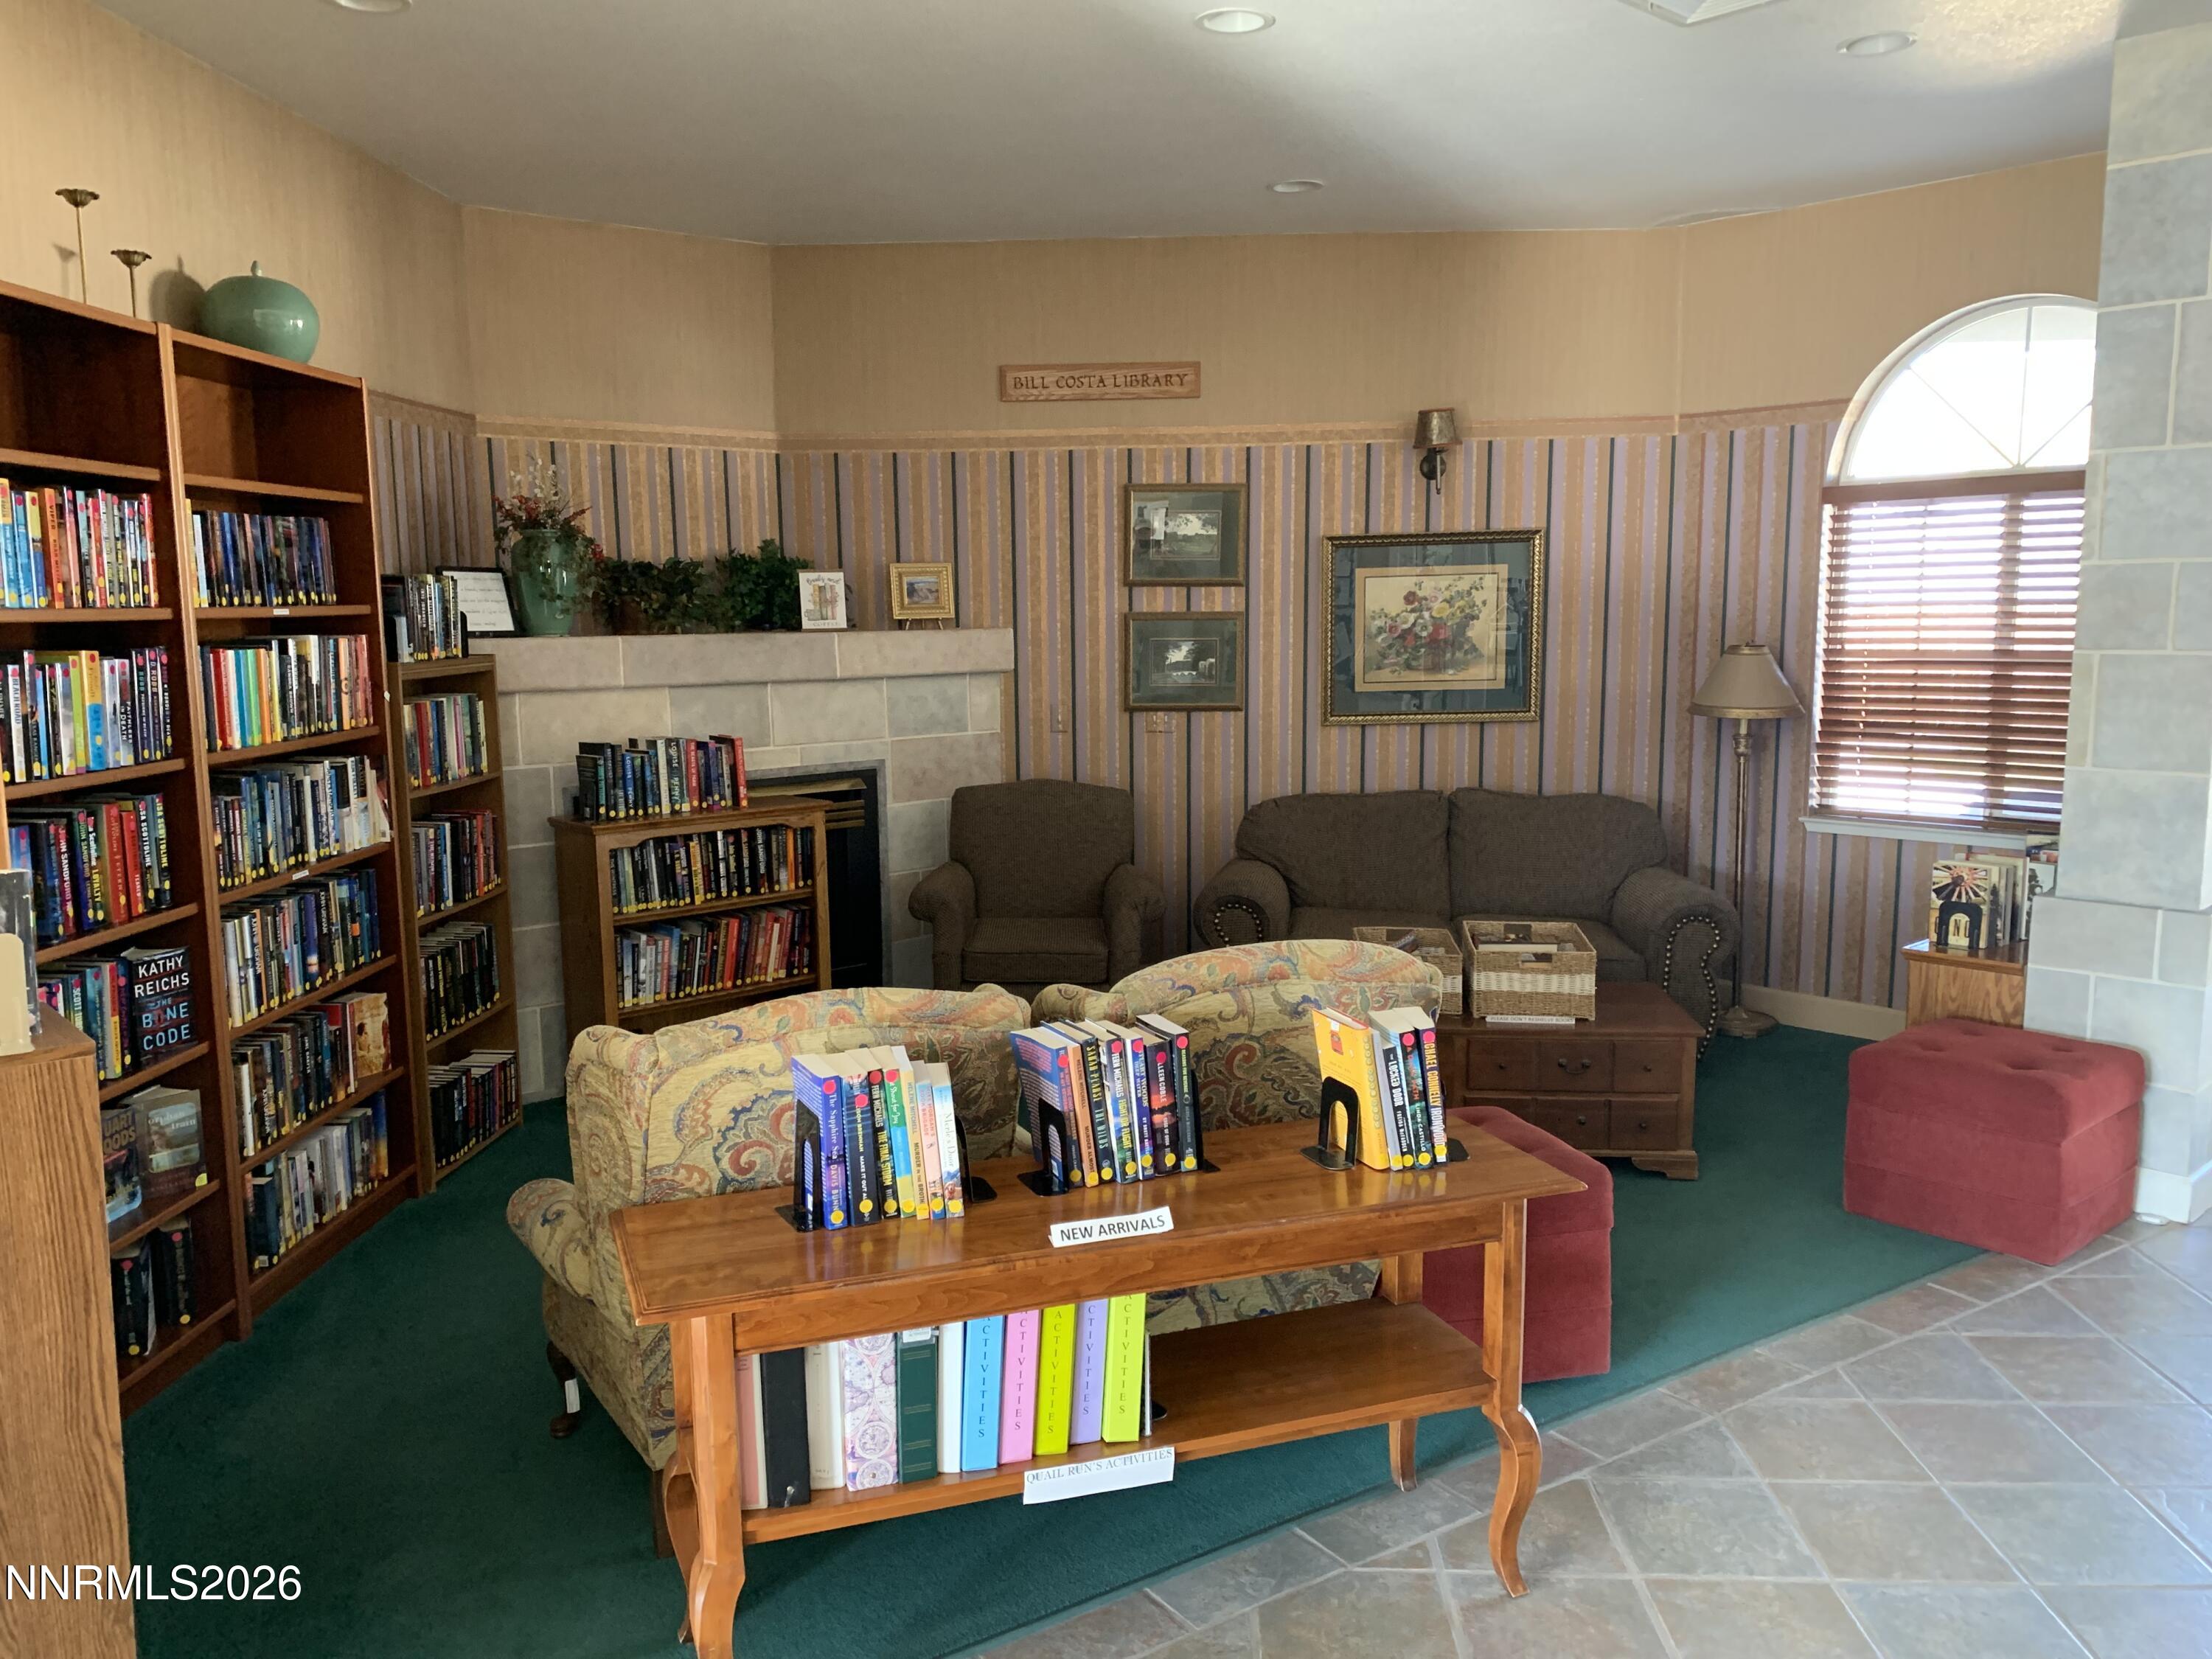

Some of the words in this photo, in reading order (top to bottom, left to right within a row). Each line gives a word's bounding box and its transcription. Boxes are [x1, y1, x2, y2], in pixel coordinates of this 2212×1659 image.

[1013, 376, 1050, 389] BILL
[1056, 375, 1107, 389] COSTA
[1113, 373, 1189, 389] LIBRARY
[13, 678, 21, 702] BEACH
[14, 703, 22, 724] ROAD
[669, 742, 678, 768] LOUISE
[672, 777, 680, 802] PENNY
[58, 827, 66, 852] JHN
[88, 832, 96, 866] Scottoline
[141, 822, 152, 867] SCOTTOLINE
[158, 817, 168, 868] SCOTTOLINE
[81, 841, 89, 877] SANDFORD
[61, 853, 72, 900] SANDFORD
[91, 869, 102, 902] LOYALTY
[138, 955, 184, 978] KATHY
[134, 973, 189, 998] REICHS
[73, 988, 81, 1010] SCOTT
[156, 997, 172, 1008] THE
[142, 1002, 189, 1028] BONE
[143, 1023, 190, 1051] CODE
[1086, 1046, 1098, 1071] SARAH
[1112, 1052, 1121, 1068] FERN
[1113, 1068, 1124, 1098] MICHAELS
[1157, 1062, 1166, 1082] LLEEN
[1388, 1061, 1399, 1087] LOCKED
[828, 1093, 837, 1108] The
[871, 1085, 880, 1099] FERN
[889, 1088, 897, 1105] Shout
[1078, 1082, 1086, 1109] MITCHELL
[1090, 1074, 1102, 1102] PEARSE
[1140, 1078, 1149, 1107] WOODS
[1159, 1082, 1167, 1103] COBLE
[1392, 1088, 1404, 1107] DOOR
[1427, 1071, 1441, 1106] CONNELLY
[873, 1100, 884, 1127] MICHAELS
[891, 1113, 900, 1124] Joy
[908, 1106, 917, 1134] MITCHELL
[1094, 1108, 1105, 1123] THE
[1118, 1098, 1127, 1117] FIGHT
[829, 1110, 839, 1144] Sapphire
[944, 1113, 955, 1144] Merle's
[1120, 1118, 1129, 1127] OR
[856, 1124, 864, 1152] BRENNAN
[877, 1131, 886, 1144] THE
[1096, 1125, 1108, 1150] WILDS
[1121, 1127, 1132, 1148] FLIGHT
[1417, 1123, 1427, 1152] CASTILLO
[831, 1146, 840, 1160] Sea
[880, 1144, 890, 1162] FINAL
[947, 1146, 956, 1167] Door
[830, 1164, 839, 1186] DAVIS
[882, 1163, 893, 1186] STORM
[832, 1189, 841, 1211] BUNN
[1060, 1225, 1093, 1242] NEW
[1099, 1215, 1165, 1237] ARRIVALS
[1047, 1310, 1062, 1433] ACTIVITIES
[1082, 1305, 1096, 1415] CTIVITIES
[1026, 1469, 1065, 1484] QUAIL
[1068, 1461, 1102, 1476] RUN'S
[1106, 1448, 1173, 1470] ACTIVITIES
